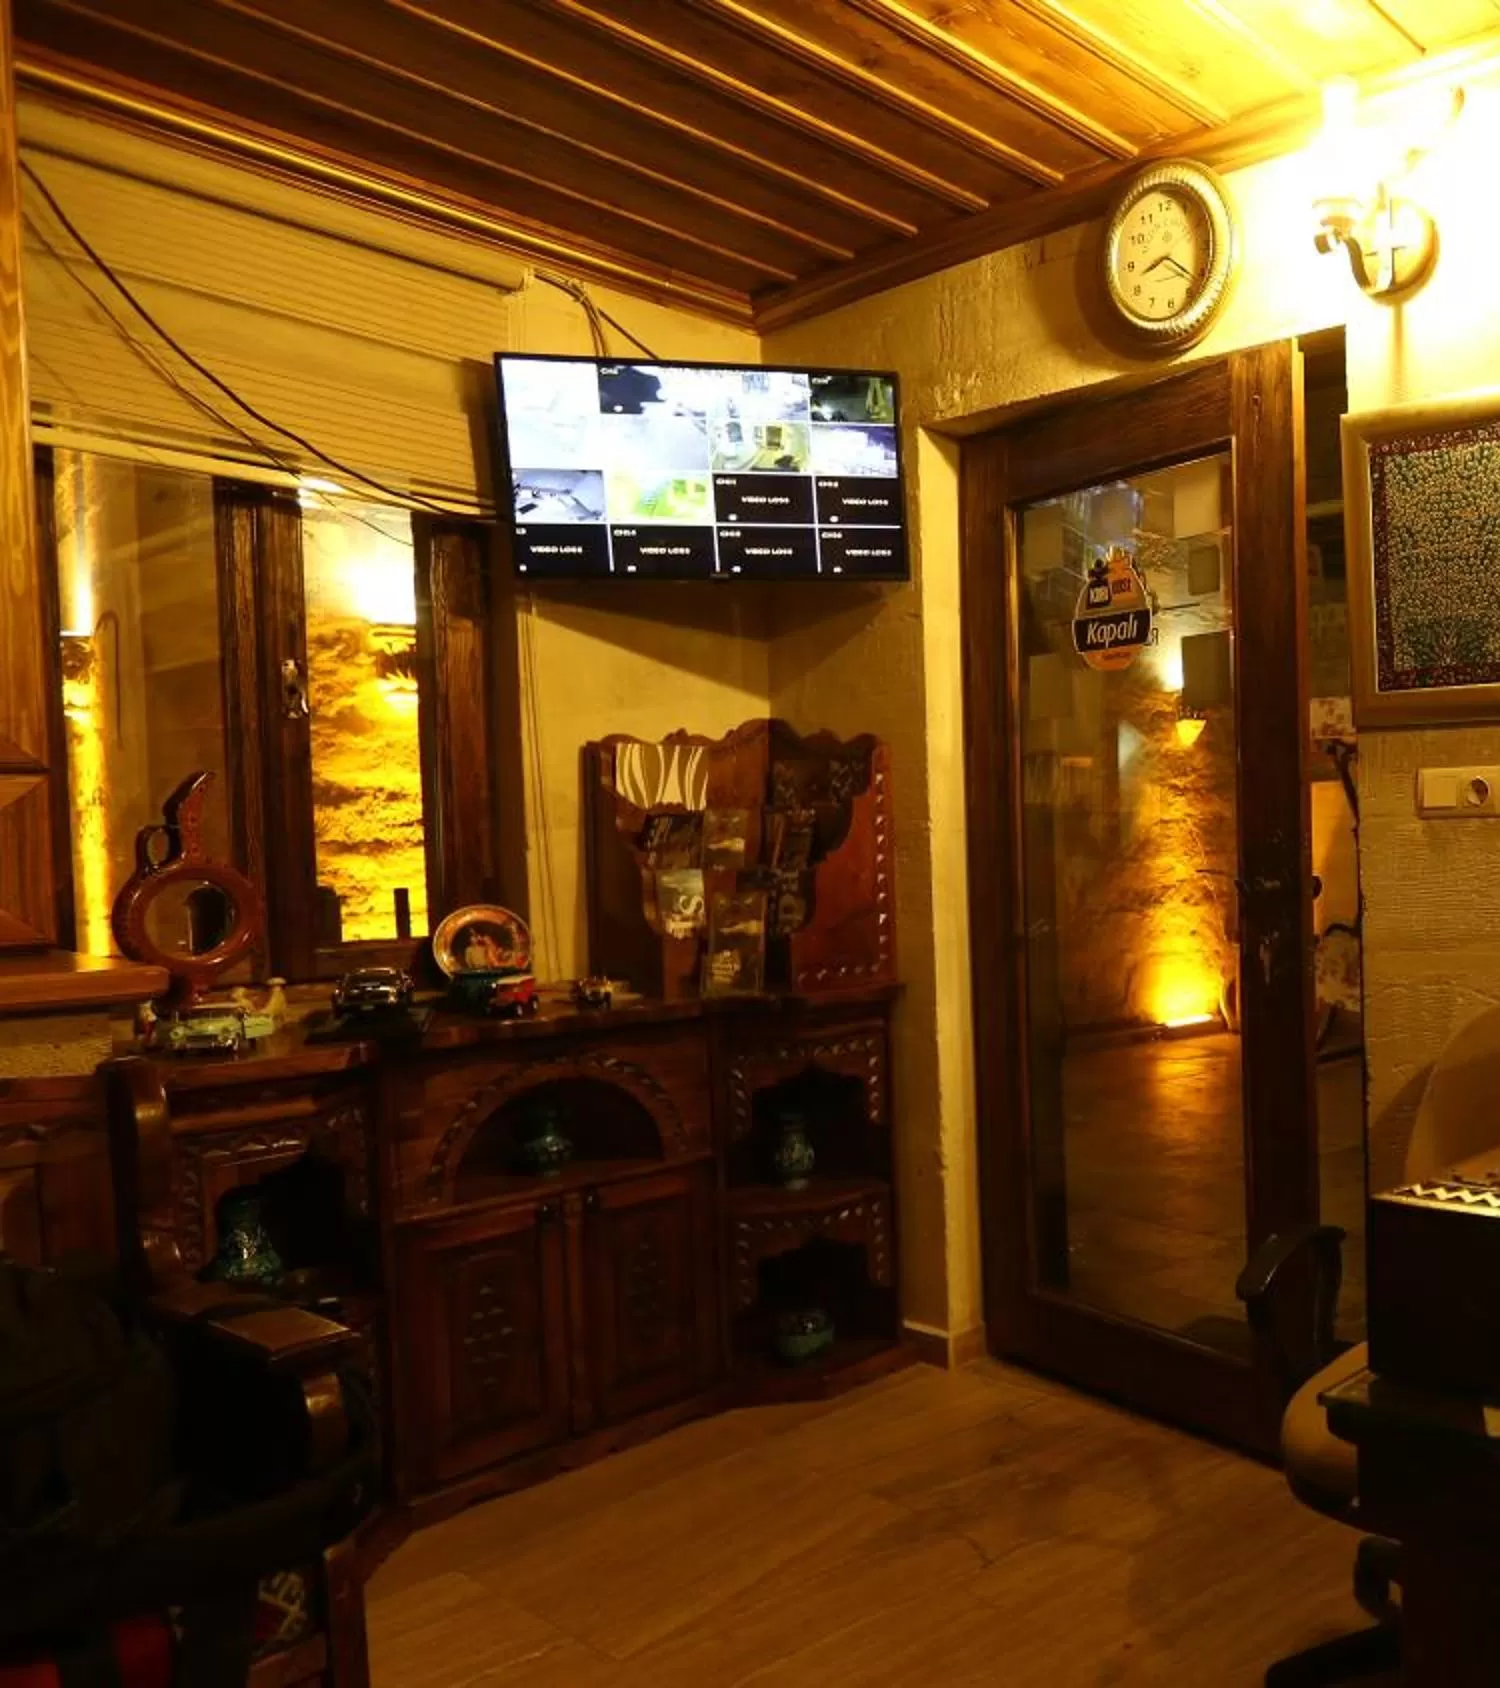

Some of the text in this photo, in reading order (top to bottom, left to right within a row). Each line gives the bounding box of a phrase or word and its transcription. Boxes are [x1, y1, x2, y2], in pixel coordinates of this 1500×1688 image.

[1158, 199, 1172, 212] 12
[1140, 213, 1154, 225] 11
[1130, 234, 1145, 246] 10
[1127, 260, 1135, 272] 9
[1133, 286, 1142, 297] 8
[1148, 297, 1156, 309] 7
[1167, 298, 1175, 309] 6
[741, 495, 790, 505] VIDEO LOSS
[842, 497, 889, 506] VIDEO LOSS
[530, 545, 583, 554] VIDEO LOSS
[640, 546, 691, 555] VIDEO LOSS
[745, 547, 794, 556] VIDEO LOSS
[845, 548, 871, 556] VIDEO
[1086, 613, 1139, 648] Kapalı
